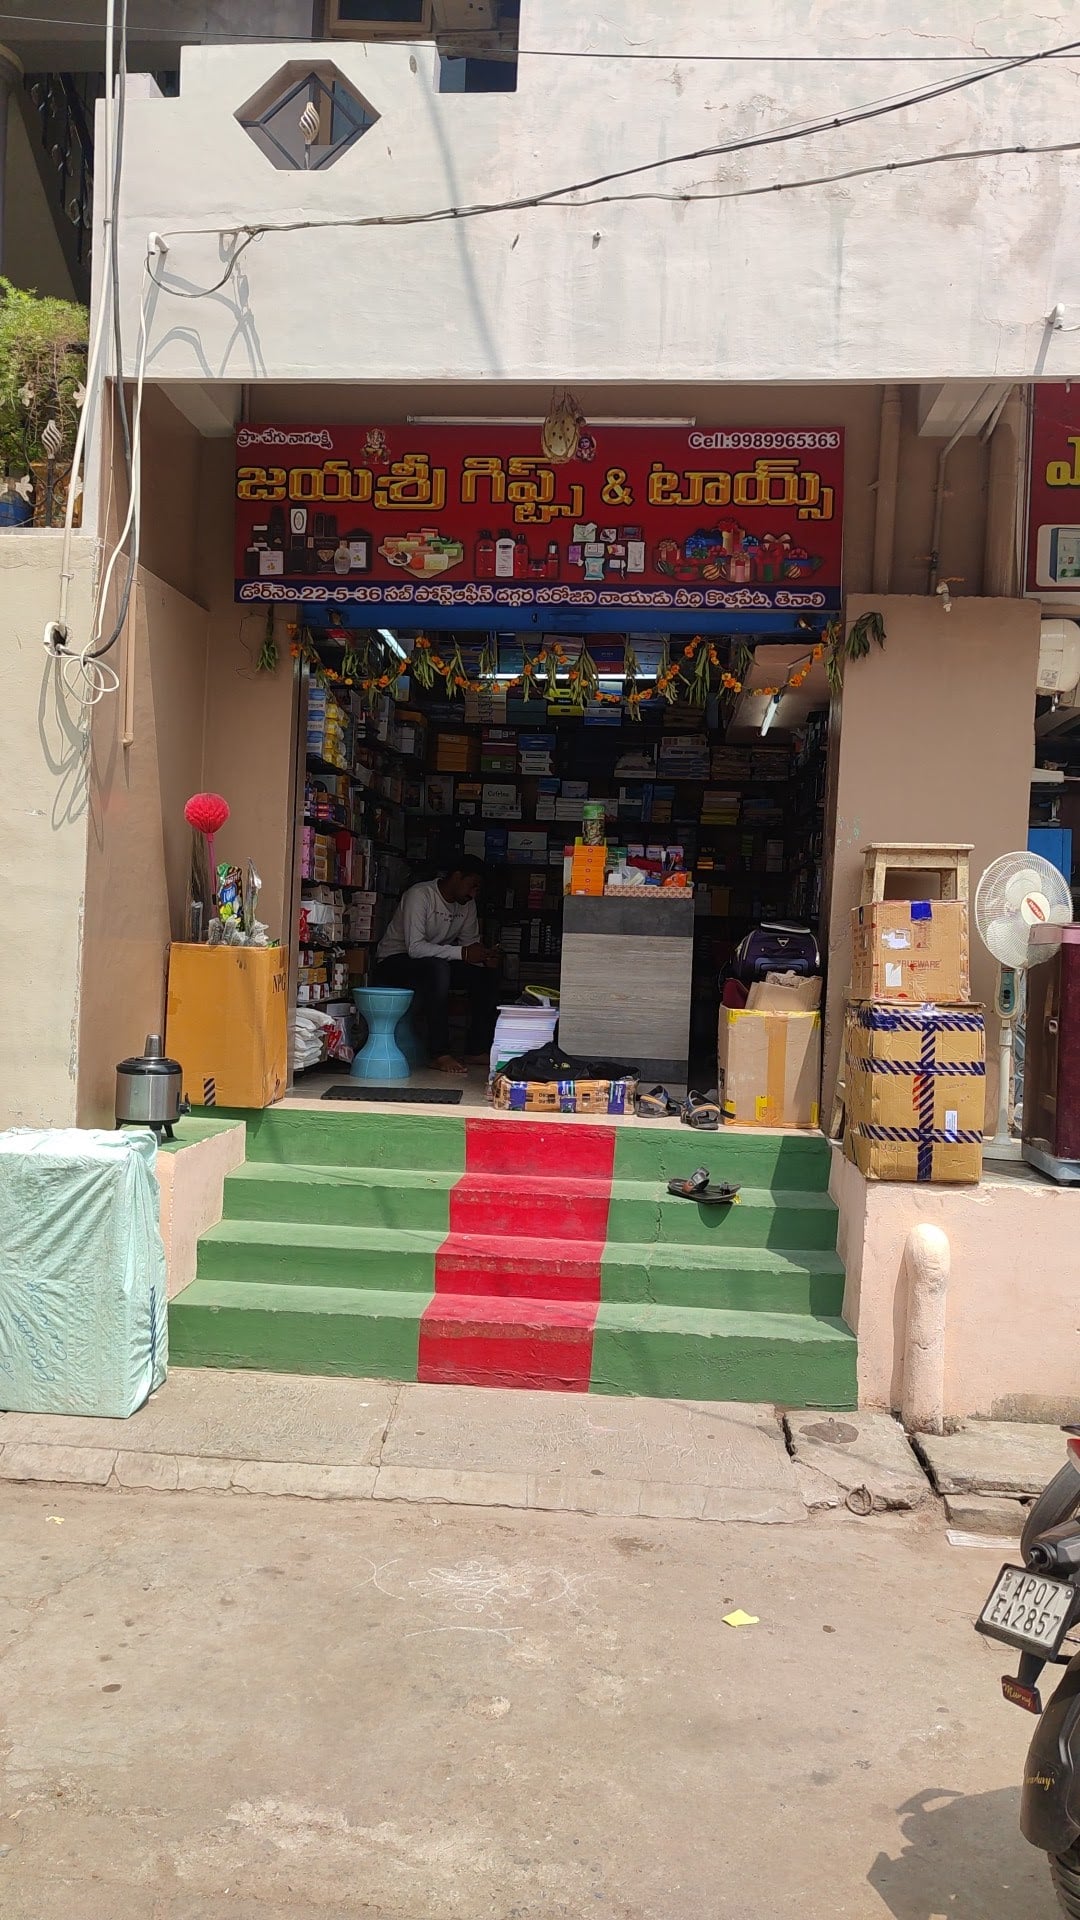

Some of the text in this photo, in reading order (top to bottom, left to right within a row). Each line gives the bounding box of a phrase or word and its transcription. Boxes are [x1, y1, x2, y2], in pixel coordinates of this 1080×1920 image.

[688, 432, 841, 449] Cell:9989965363
[236, 454, 448, 511] జయశ్రీ
[601, 467, 635, 506] &
[648, 459, 835, 521] టాయ్స్
[598, 590, 673, 606] నాయుడు
[774, 591, 826, 607] తెనాలి
[1012, 1576, 1060, 1610] AP07
[990, 1597, 1061, 1640] EA2857
